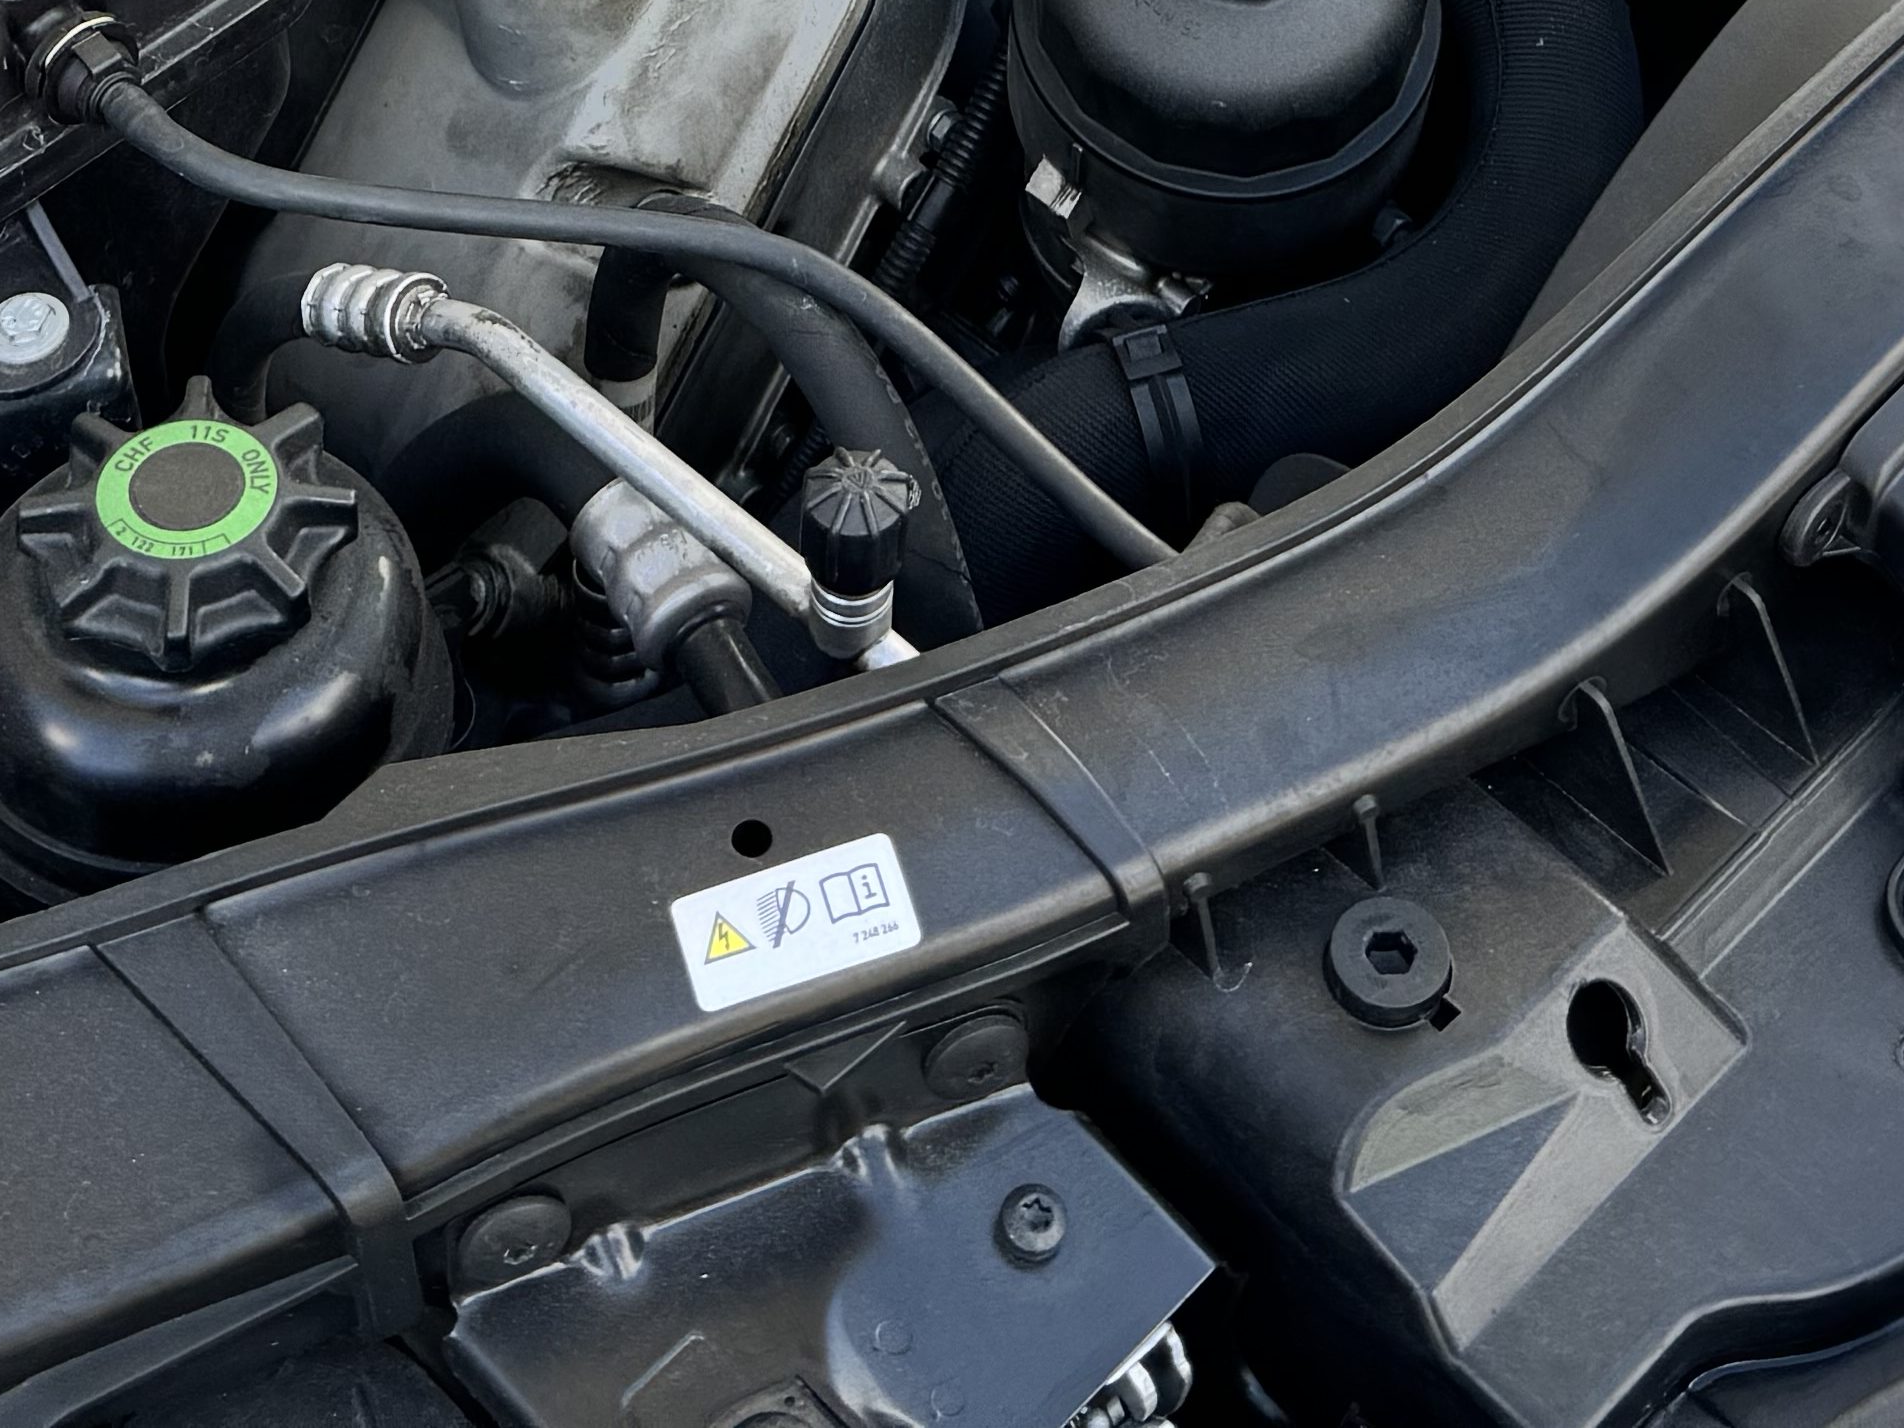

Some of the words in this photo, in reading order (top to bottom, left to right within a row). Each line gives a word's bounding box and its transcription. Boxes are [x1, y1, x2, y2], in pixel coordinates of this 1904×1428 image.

[114, 436, 154, 472] CHF
[189, 424, 231, 443] 11S
[240, 448, 271, 495] ONLY
